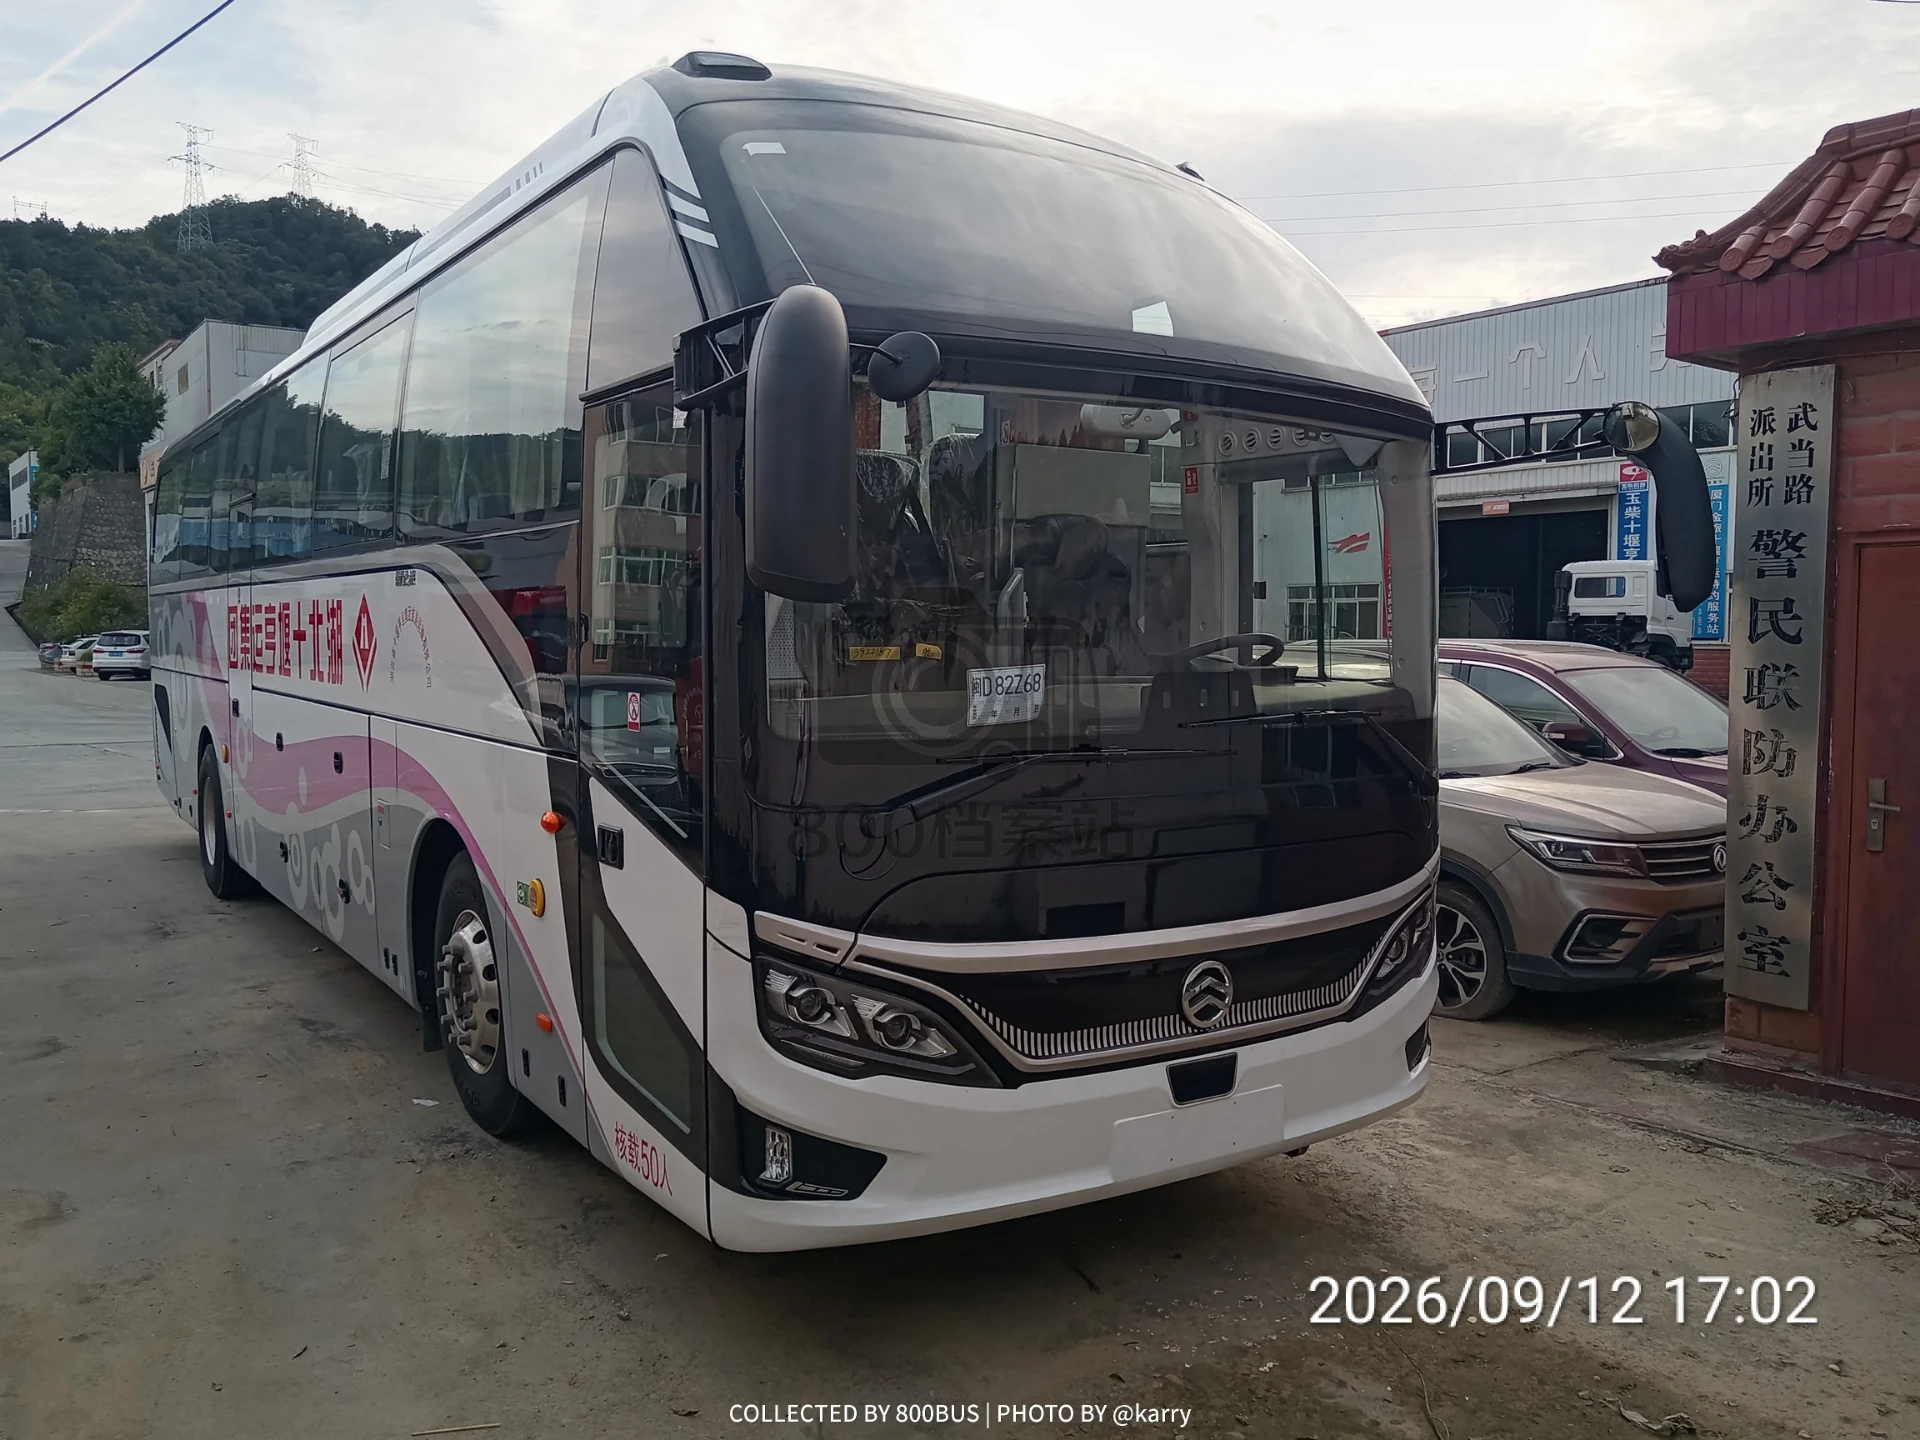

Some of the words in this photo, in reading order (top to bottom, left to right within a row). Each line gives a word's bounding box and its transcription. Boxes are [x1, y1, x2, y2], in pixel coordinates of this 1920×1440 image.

[1747, 406, 1778, 508] 派出所
[1784, 402, 1819, 506] 武当路
[1736, 528, 1809, 978] 警民联防办公室
[614, 1120, 673, 1197] 核载50人
